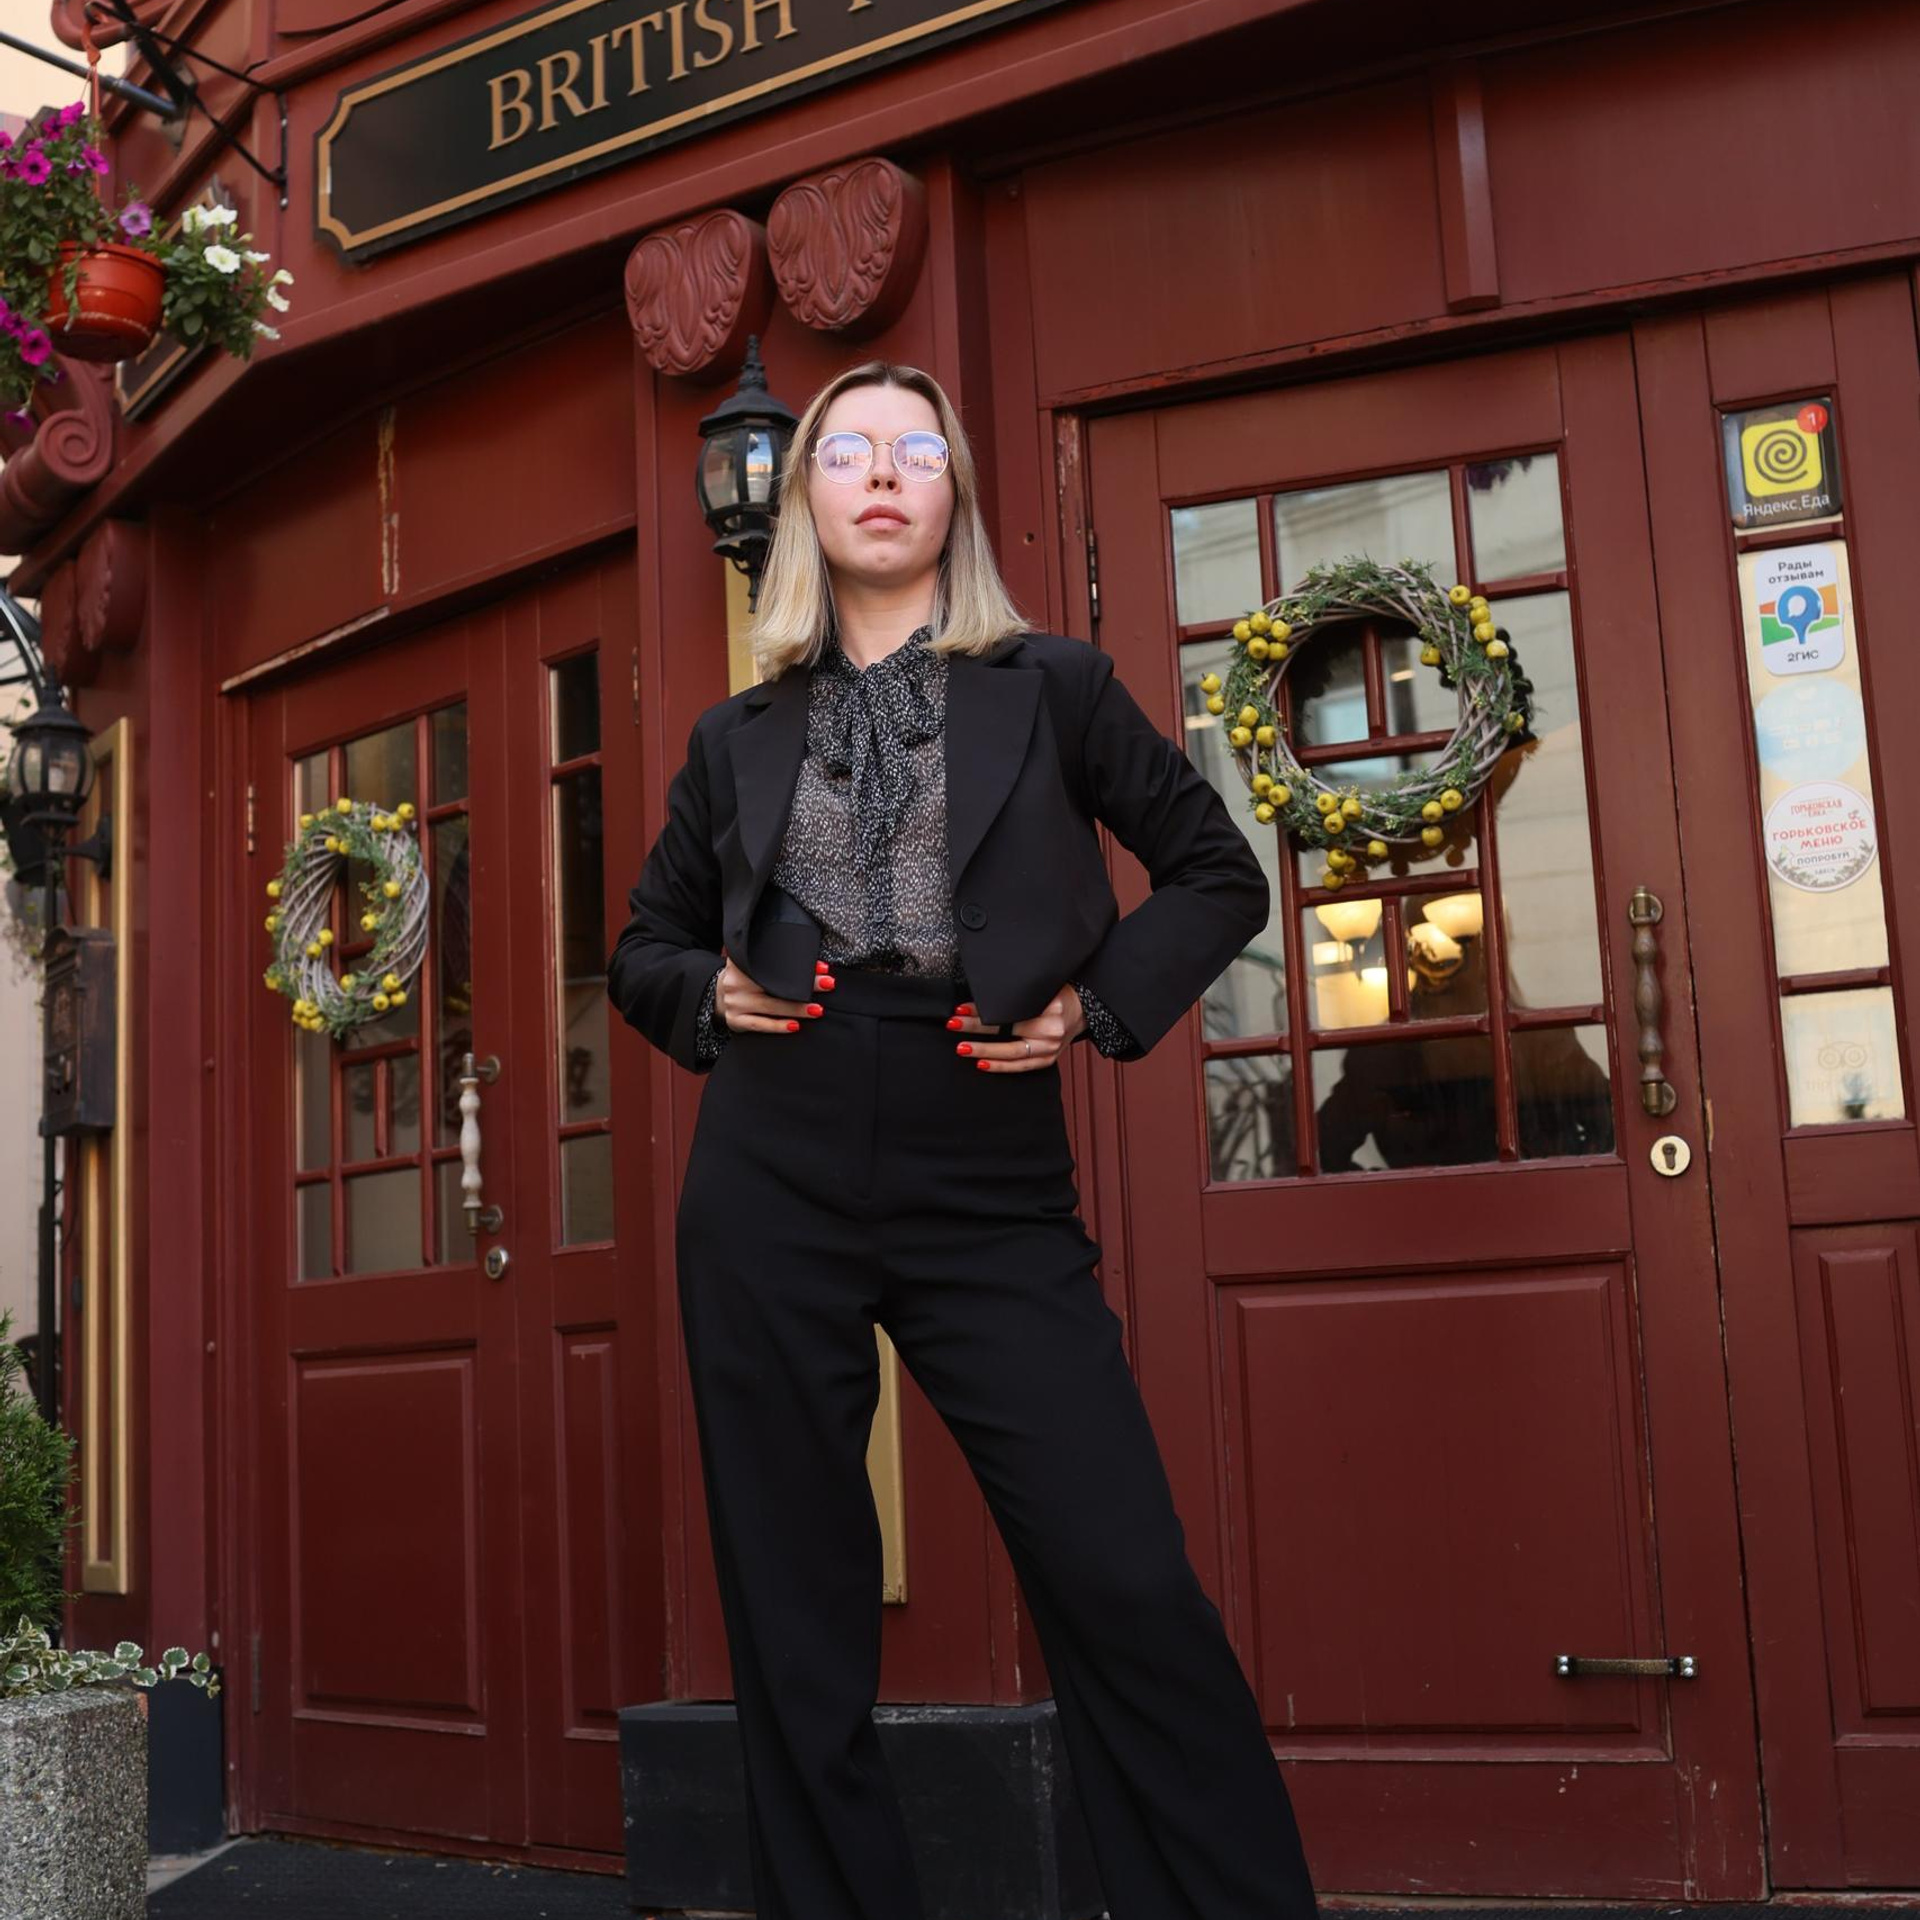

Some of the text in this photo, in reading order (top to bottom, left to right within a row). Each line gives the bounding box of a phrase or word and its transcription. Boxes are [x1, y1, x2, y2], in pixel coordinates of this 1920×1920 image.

[487, 0, 798, 151] BRITISH
[1778, 560, 1812, 571] Рады
[1768, 571, 1824, 584] отзывам
[1787, 650, 1819, 662] 2ГИС
[1773, 819, 1867, 841] ГОРЬКОВСКОЕ
[1801, 834, 1843, 849] МЕНЮ
